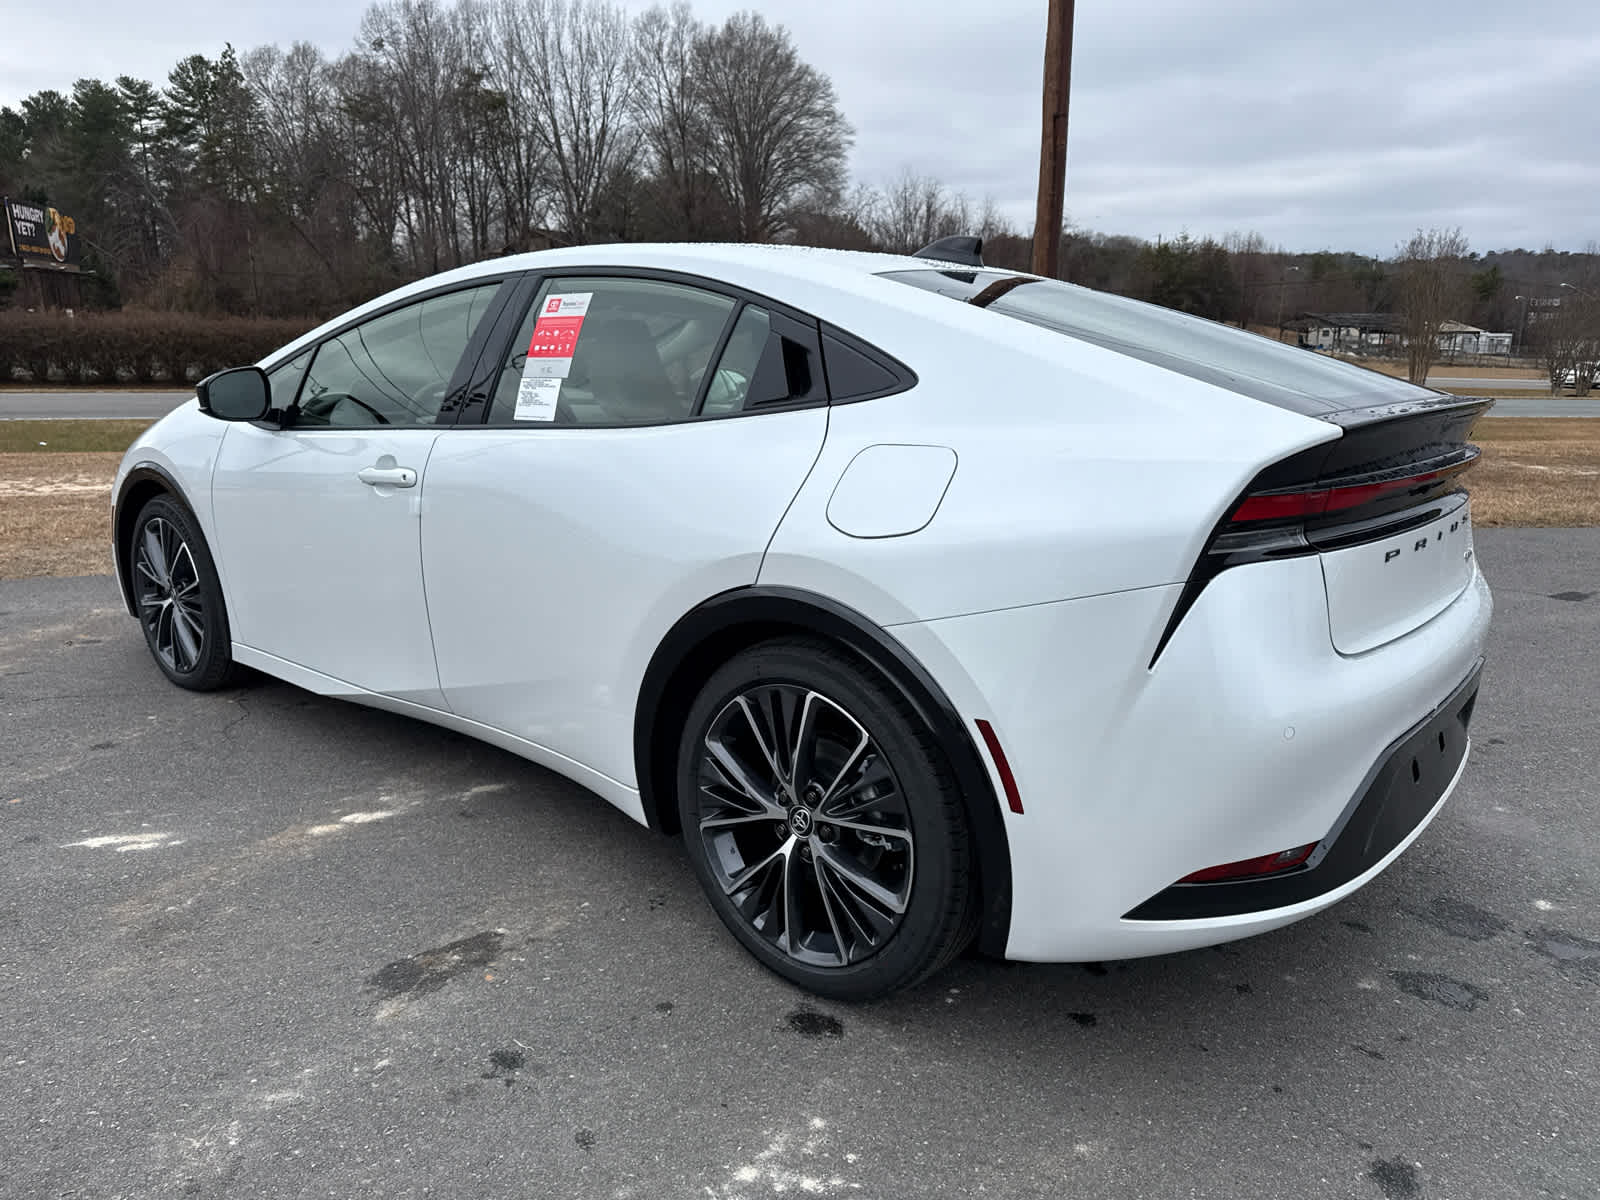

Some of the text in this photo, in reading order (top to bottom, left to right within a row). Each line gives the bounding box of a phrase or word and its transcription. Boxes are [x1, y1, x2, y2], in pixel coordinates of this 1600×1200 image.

[11, 203, 44, 224] HUNGRY
[14, 220, 36, 237] YET?
[1384, 512, 1469, 563] PRIUS
